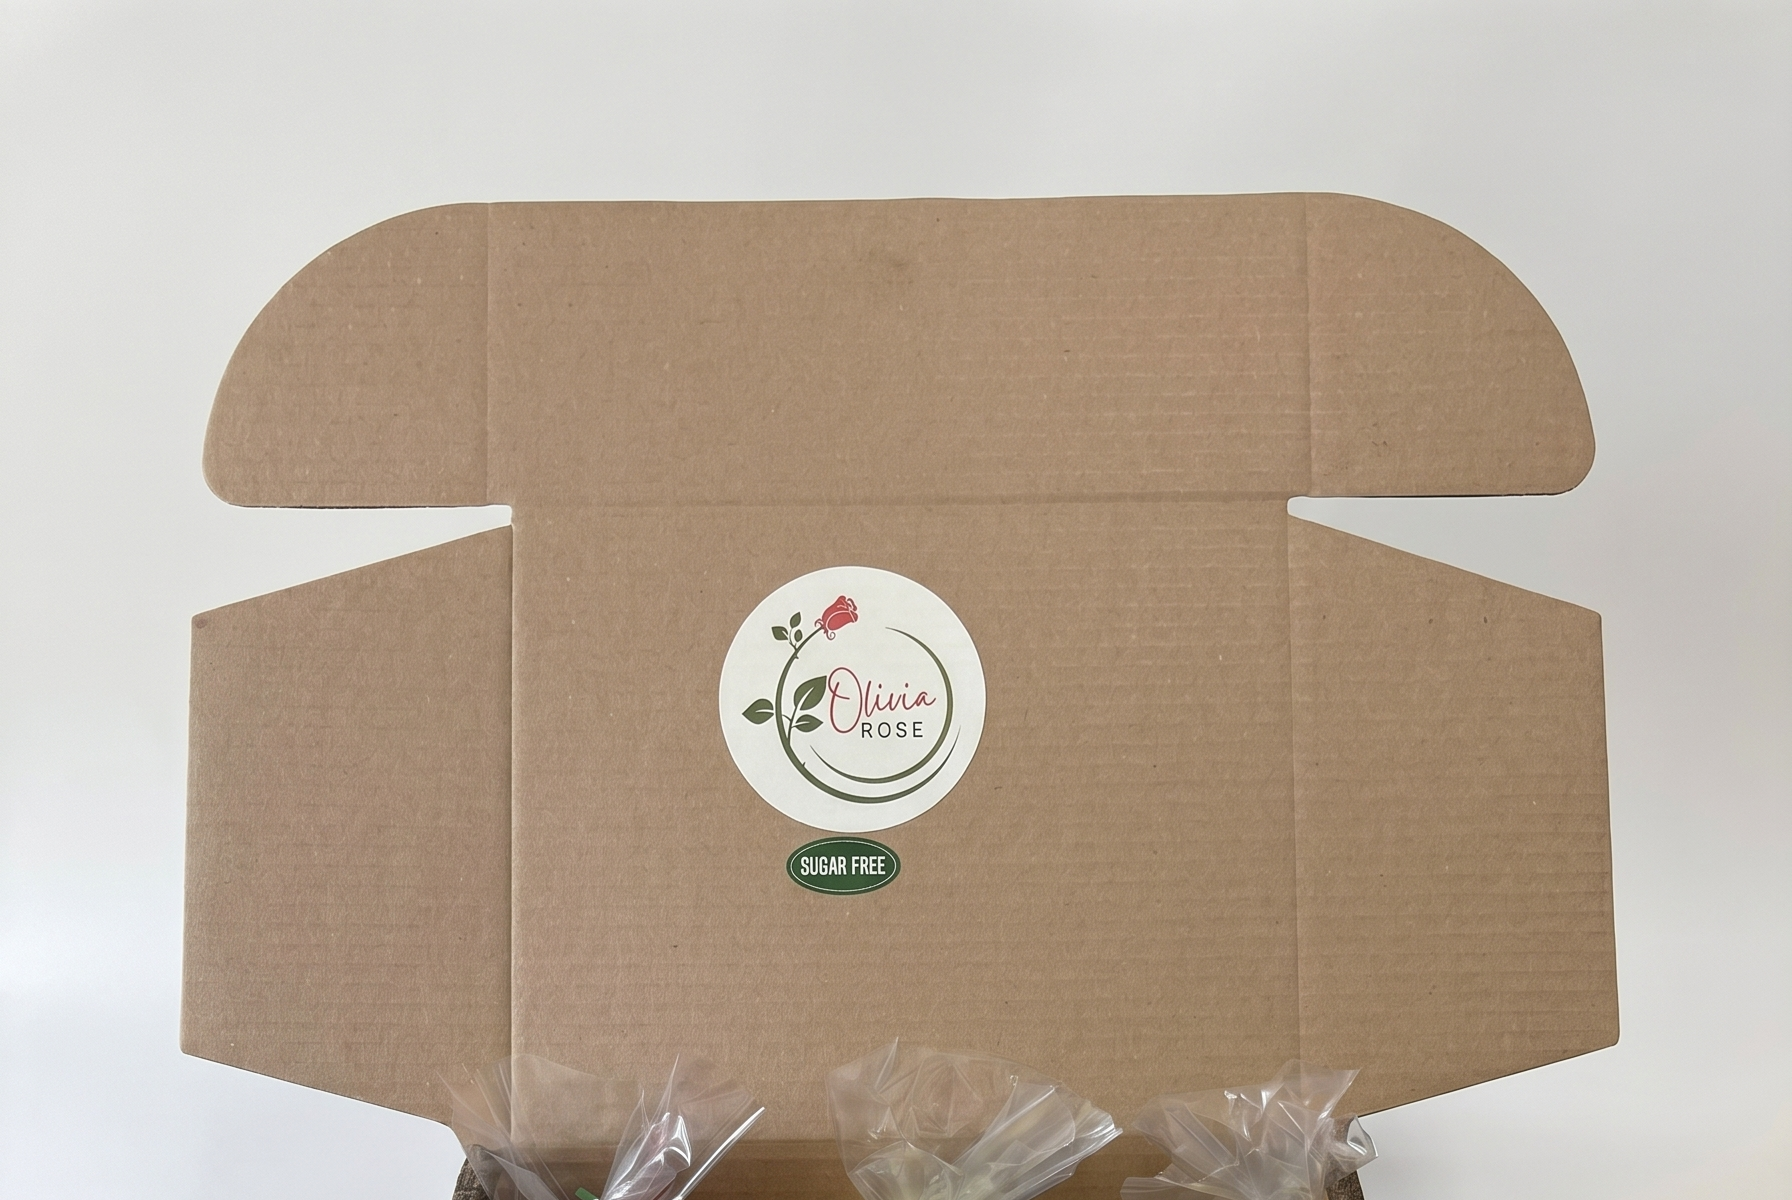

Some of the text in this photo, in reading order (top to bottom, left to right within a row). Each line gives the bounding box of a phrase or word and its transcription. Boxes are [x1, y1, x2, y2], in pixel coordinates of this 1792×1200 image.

[828, 666, 936, 733] Olivia
[861, 721, 923, 739] ROSE
[800, 855, 886, 876] SUGAR FREE
